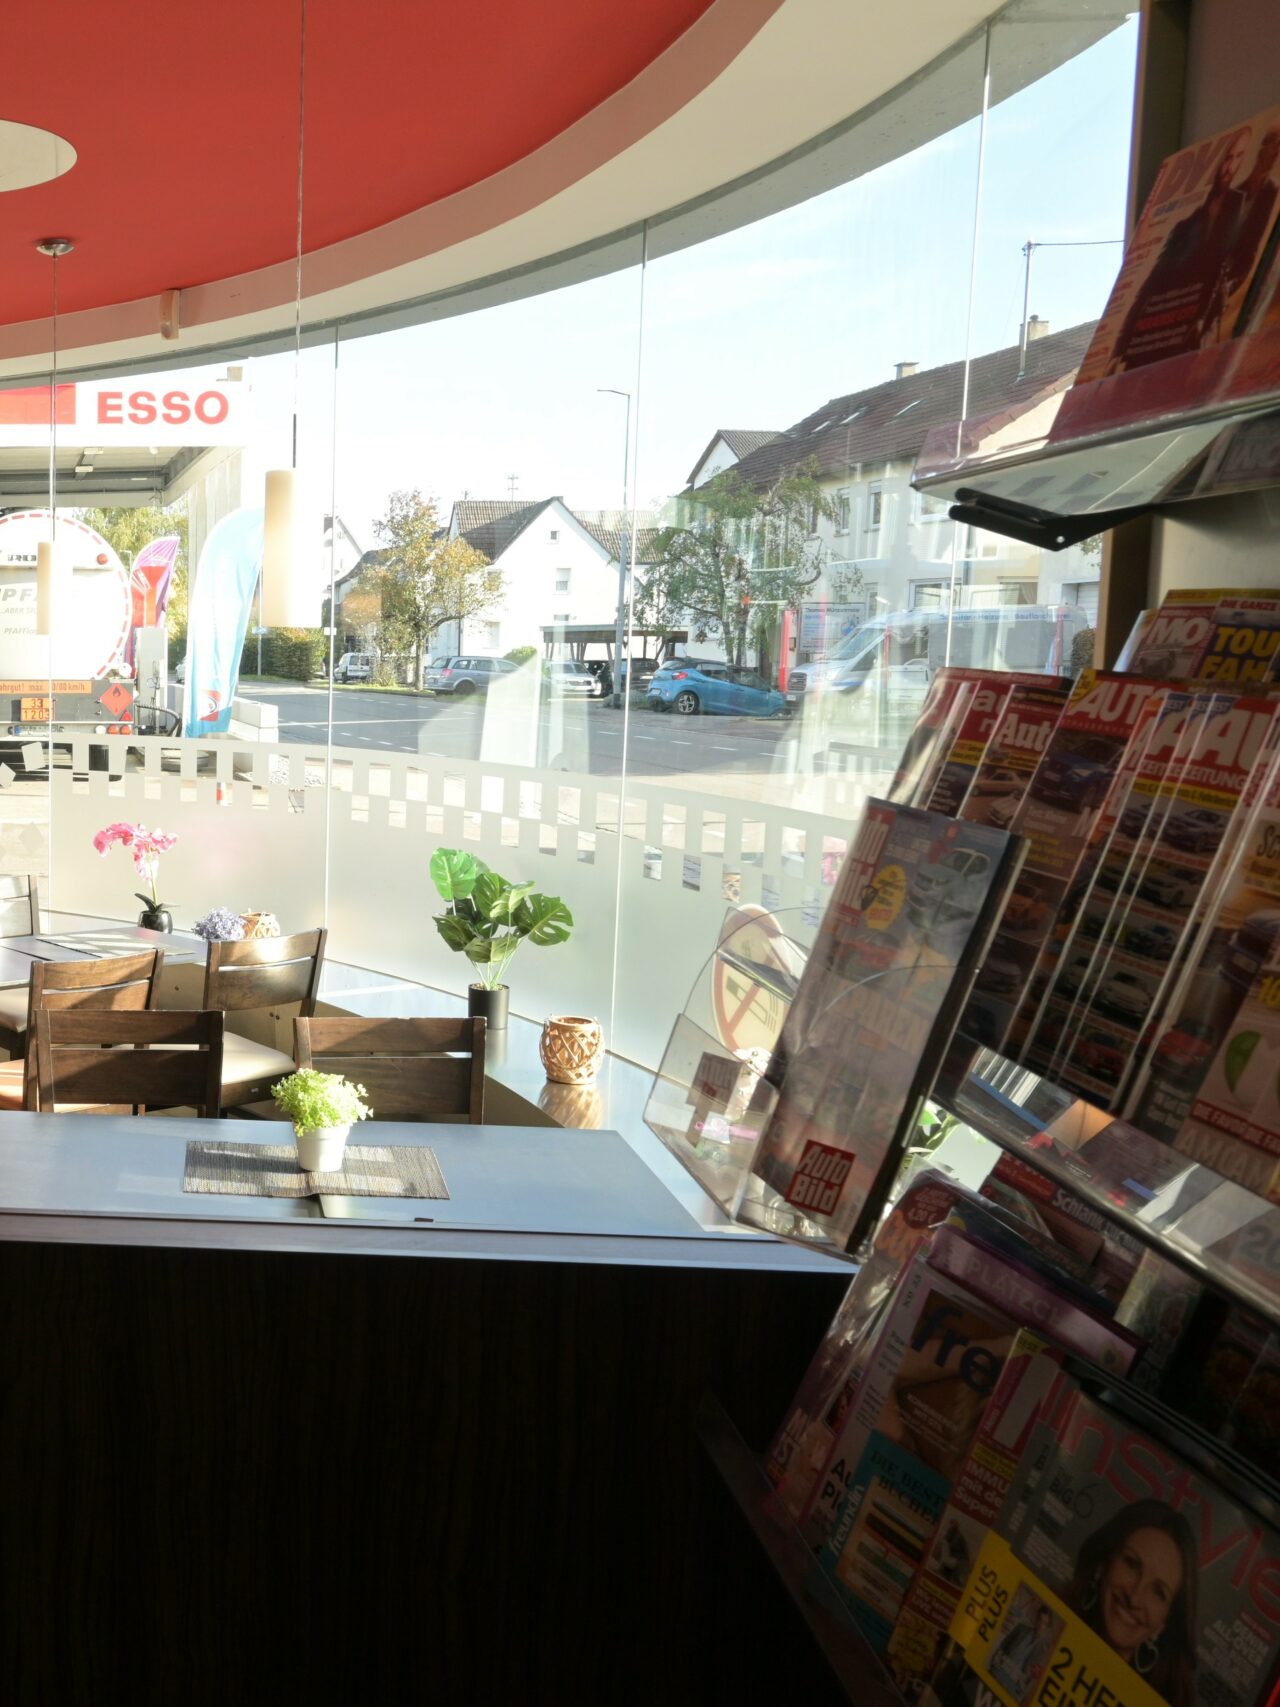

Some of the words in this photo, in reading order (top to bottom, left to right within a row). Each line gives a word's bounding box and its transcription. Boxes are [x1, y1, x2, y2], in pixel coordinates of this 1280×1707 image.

[96, 390, 230, 426] ESSO
[24, 710, 51, 721] 1203
[31, 698, 44, 708] 33
[1066, 680, 1170, 725] AUT
[796, 1145, 851, 1187] Auto
[790, 1175, 840, 1214] Bild
[868, 1450, 900, 1475] DIE
[1052, 1647, 1075, 1680] 2
